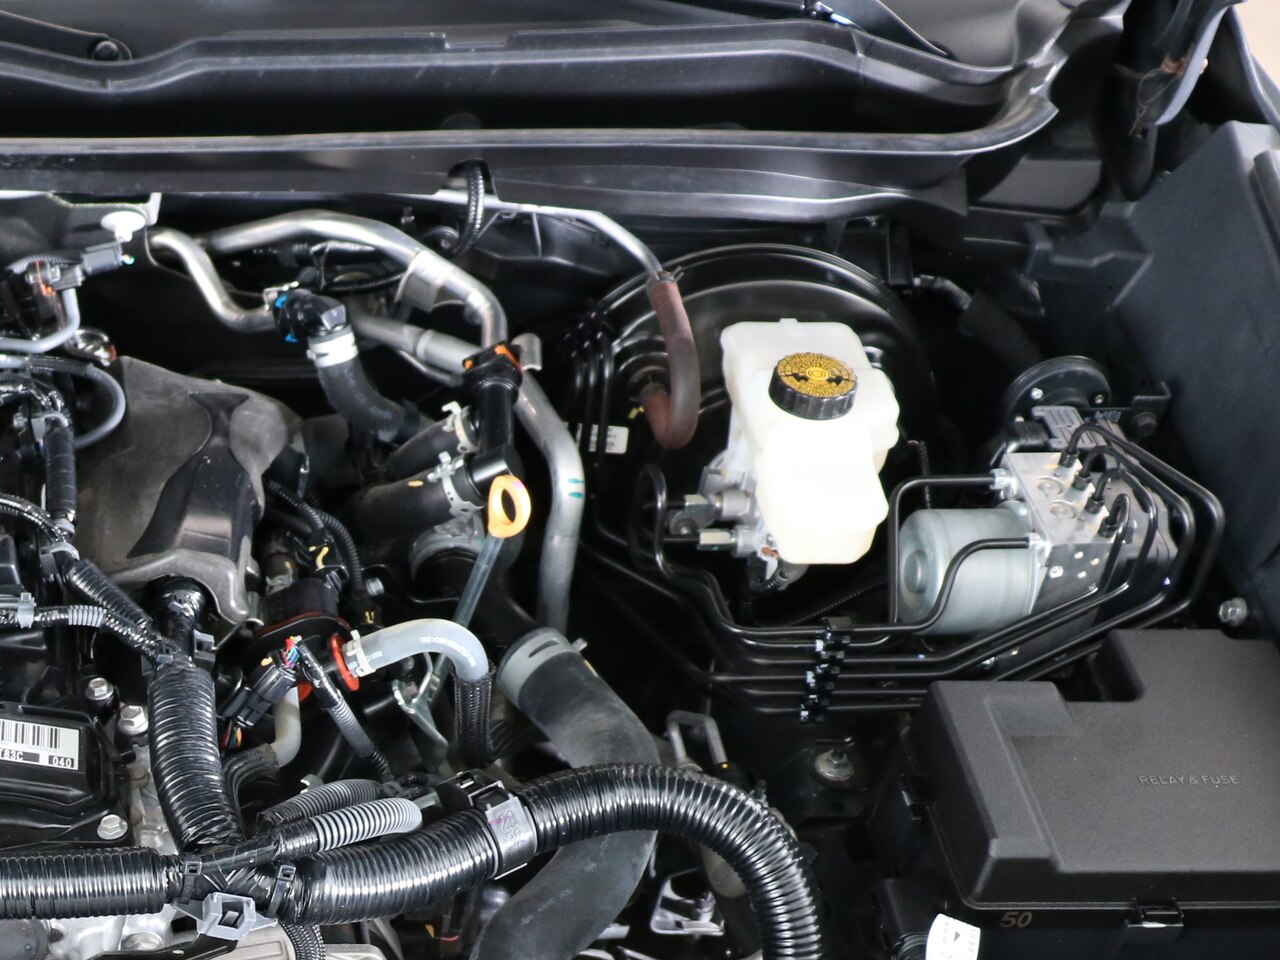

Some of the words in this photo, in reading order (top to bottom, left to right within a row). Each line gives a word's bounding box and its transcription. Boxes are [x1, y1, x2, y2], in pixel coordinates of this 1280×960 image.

[52, 757, 73, 768] 040
[1138, 775, 1184, 785] RELAY
[1189, 775, 1198, 784] &
[1201, 775, 1239, 785] FUSE
[1000, 911, 1033, 928] 50
